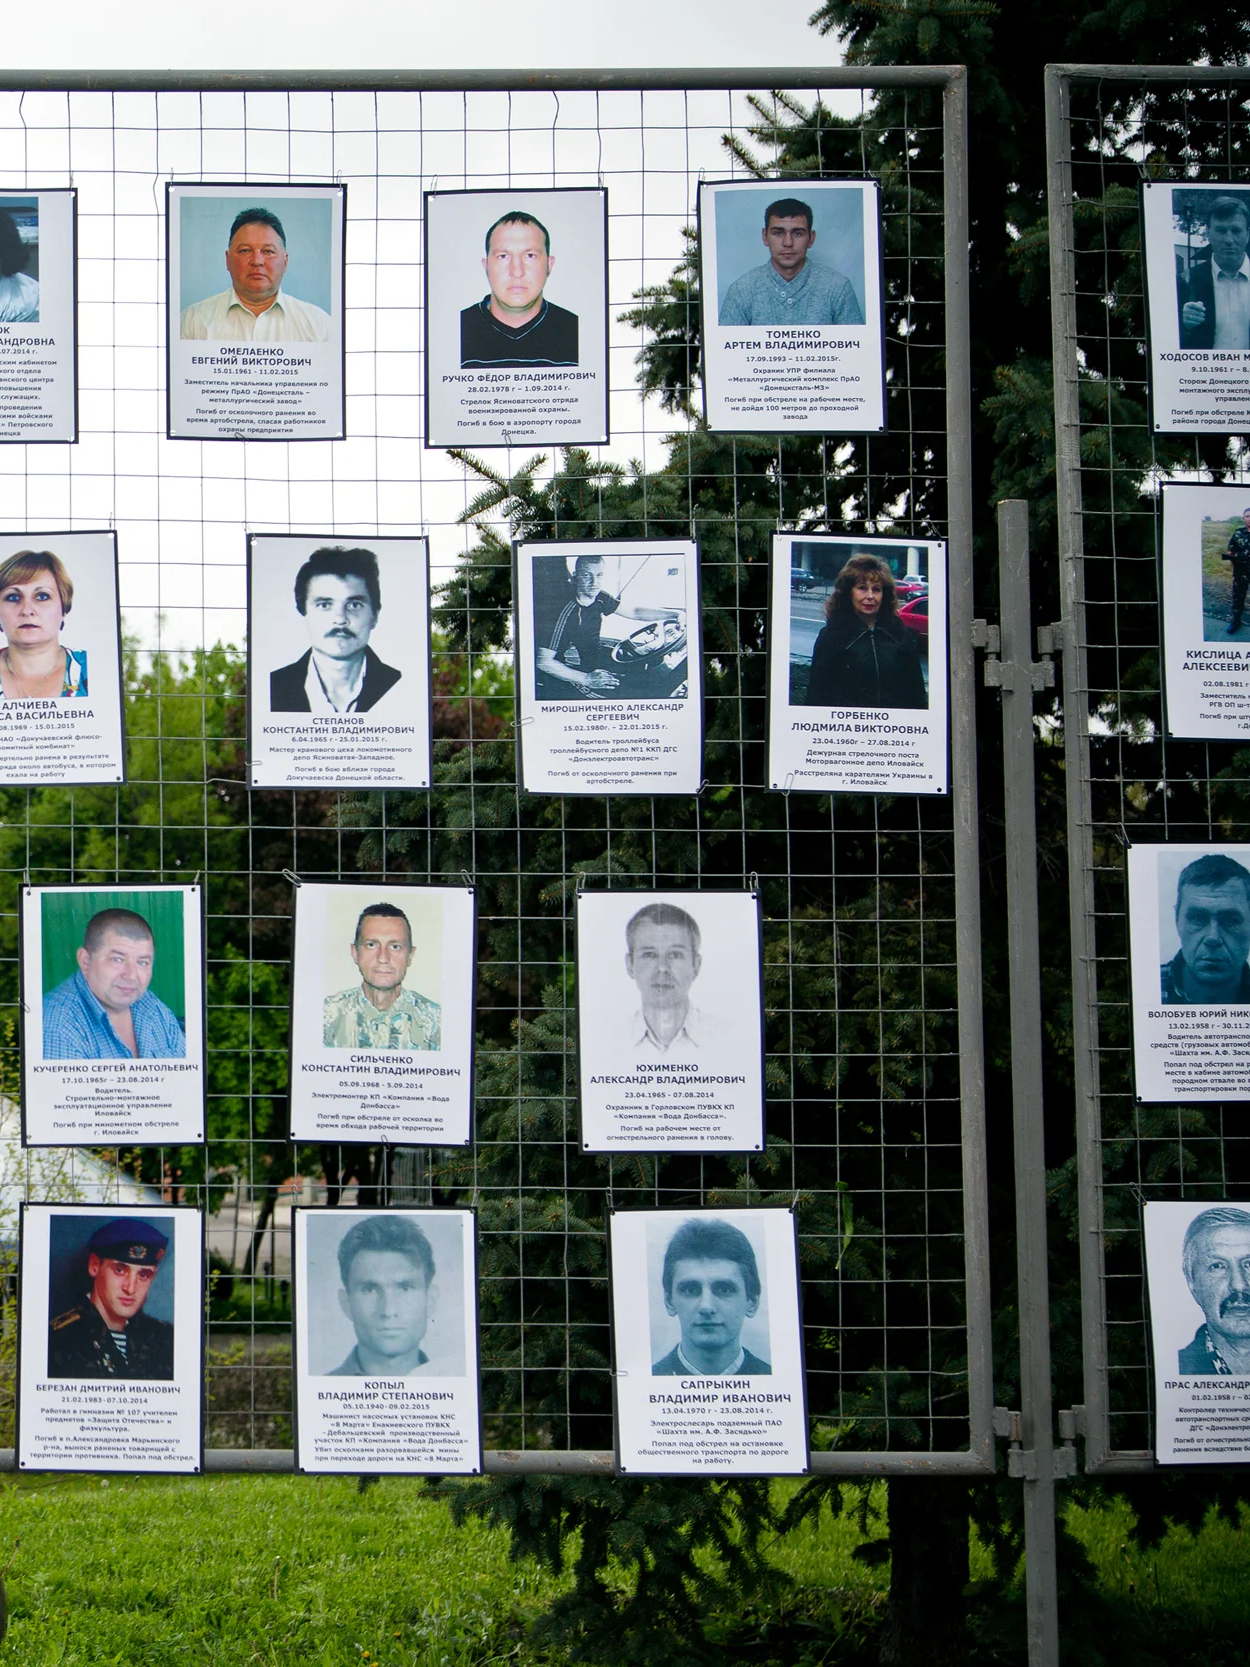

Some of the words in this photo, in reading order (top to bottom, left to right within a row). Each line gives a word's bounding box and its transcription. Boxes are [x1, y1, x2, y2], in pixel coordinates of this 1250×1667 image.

[766, 330, 821, 339] ТОМЕНКО
[724, 341, 761, 349] АРТЕМ
[765, 341, 860, 350] ВЛАДИМИРОВИЧ
[192, 355, 238, 365] ЕВГЕНИЙ
[242, 358, 311, 366] ВИКТОРОВИЧ
[1160, 353, 1209, 362] ХОДОСОВ
[1212, 353, 1240, 361] ИВАН
[442, 375, 474, 383] РУЧКО
[477, 373, 511, 383] ФЁДОР
[514, 372, 596, 382] ВЛАДИМИРОВИЧ
[1186, 650, 1242, 661] КИСЛИЦА
[1182, 662, 1250, 671] АЛЕКСЕЕВИ
[2, 701, 57, 710] АЛЧИЕВА
[541, 704, 624, 713] МИРОШНИЧЕНКО
[627, 703, 684, 712] АЛЕКСАНДР
[16, 710, 94, 720] ВАСИЛЬЕВНА
[586, 713, 639, 721] СЕРГЕЕВИЧ
[831, 711, 889, 721] ГОРБЕНКО
[312, 717, 364, 725] СТЕПАНОВ
[263, 726, 329, 734] КОНСТАНТИН
[332, 726, 414, 735] ВЛАДИМИРОВИЧ
[791, 723, 852, 733] ЛЮДМИЛА
[854, 724, 929, 734] ВИКТОРОВНА
[1199, 1009, 1227, 1018] ЮРИЙ
[350, 1055, 413, 1064] СИЛЬЧЕНКО
[33, 1065, 89, 1073] КУЧЕРЕНКО
[91, 1063, 126, 1072] СЕРГЕЙ
[129, 1064, 198, 1072] АНАТОЛЬЕВИЧ
[302, 1064, 371, 1073] КОНСТАНТИН
[374, 1066, 460, 1076] ВЛАДИМИРОВИЧ
[636, 1064, 699, 1072] ЮХИМЕНКО
[590, 1076, 654, 1085] АЛЕКСАНДР
[656, 1076, 745, 1085] ВЛАДИМИРОВИЧ
[36, 1384, 77, 1392] БЕРЕЗАН
[80, 1384, 126, 1393] ДМИТРИЙ
[364, 1381, 404, 1390] КОПЫЛ
[681, 1380, 750, 1389] САПРЫКИН
[1165, 1381, 1190, 1389] ПРАС
[318, 1392, 379, 1401] ВЛАДИМИР
[382, 1392, 454, 1400] СТЕПАНОВИЧ
[649, 1394, 718, 1405] ВЛАДИМИР
[723, 1394, 791, 1403] ИВАНОВИЧ
